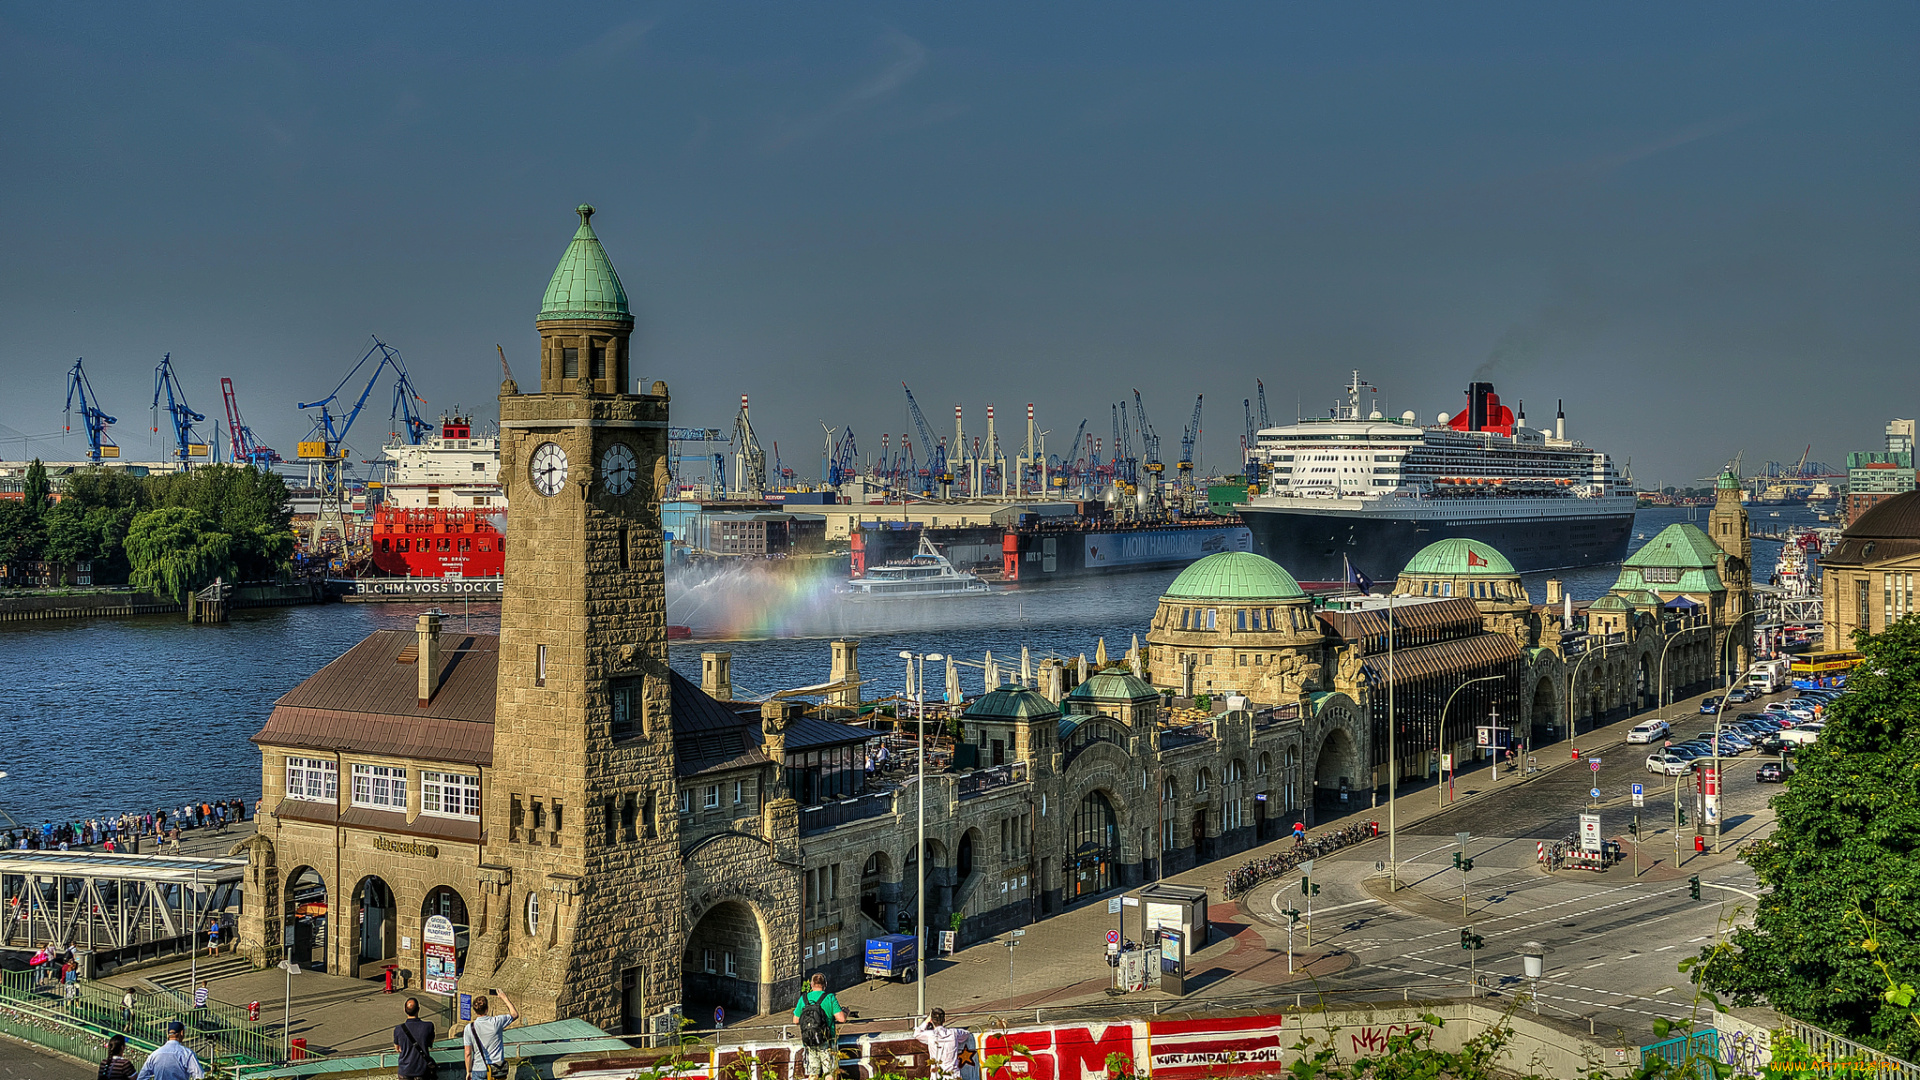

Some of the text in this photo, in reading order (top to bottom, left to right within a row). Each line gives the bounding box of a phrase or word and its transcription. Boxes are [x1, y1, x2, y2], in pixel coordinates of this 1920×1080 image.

[1122, 536, 1147, 557] MOIN
[454, 582, 491, 593] DOCK
[427, 980, 454, 992] KASSE
[1156, 1053, 1184, 1065] KURT
[1249, 1049, 1278, 1061] 2014
